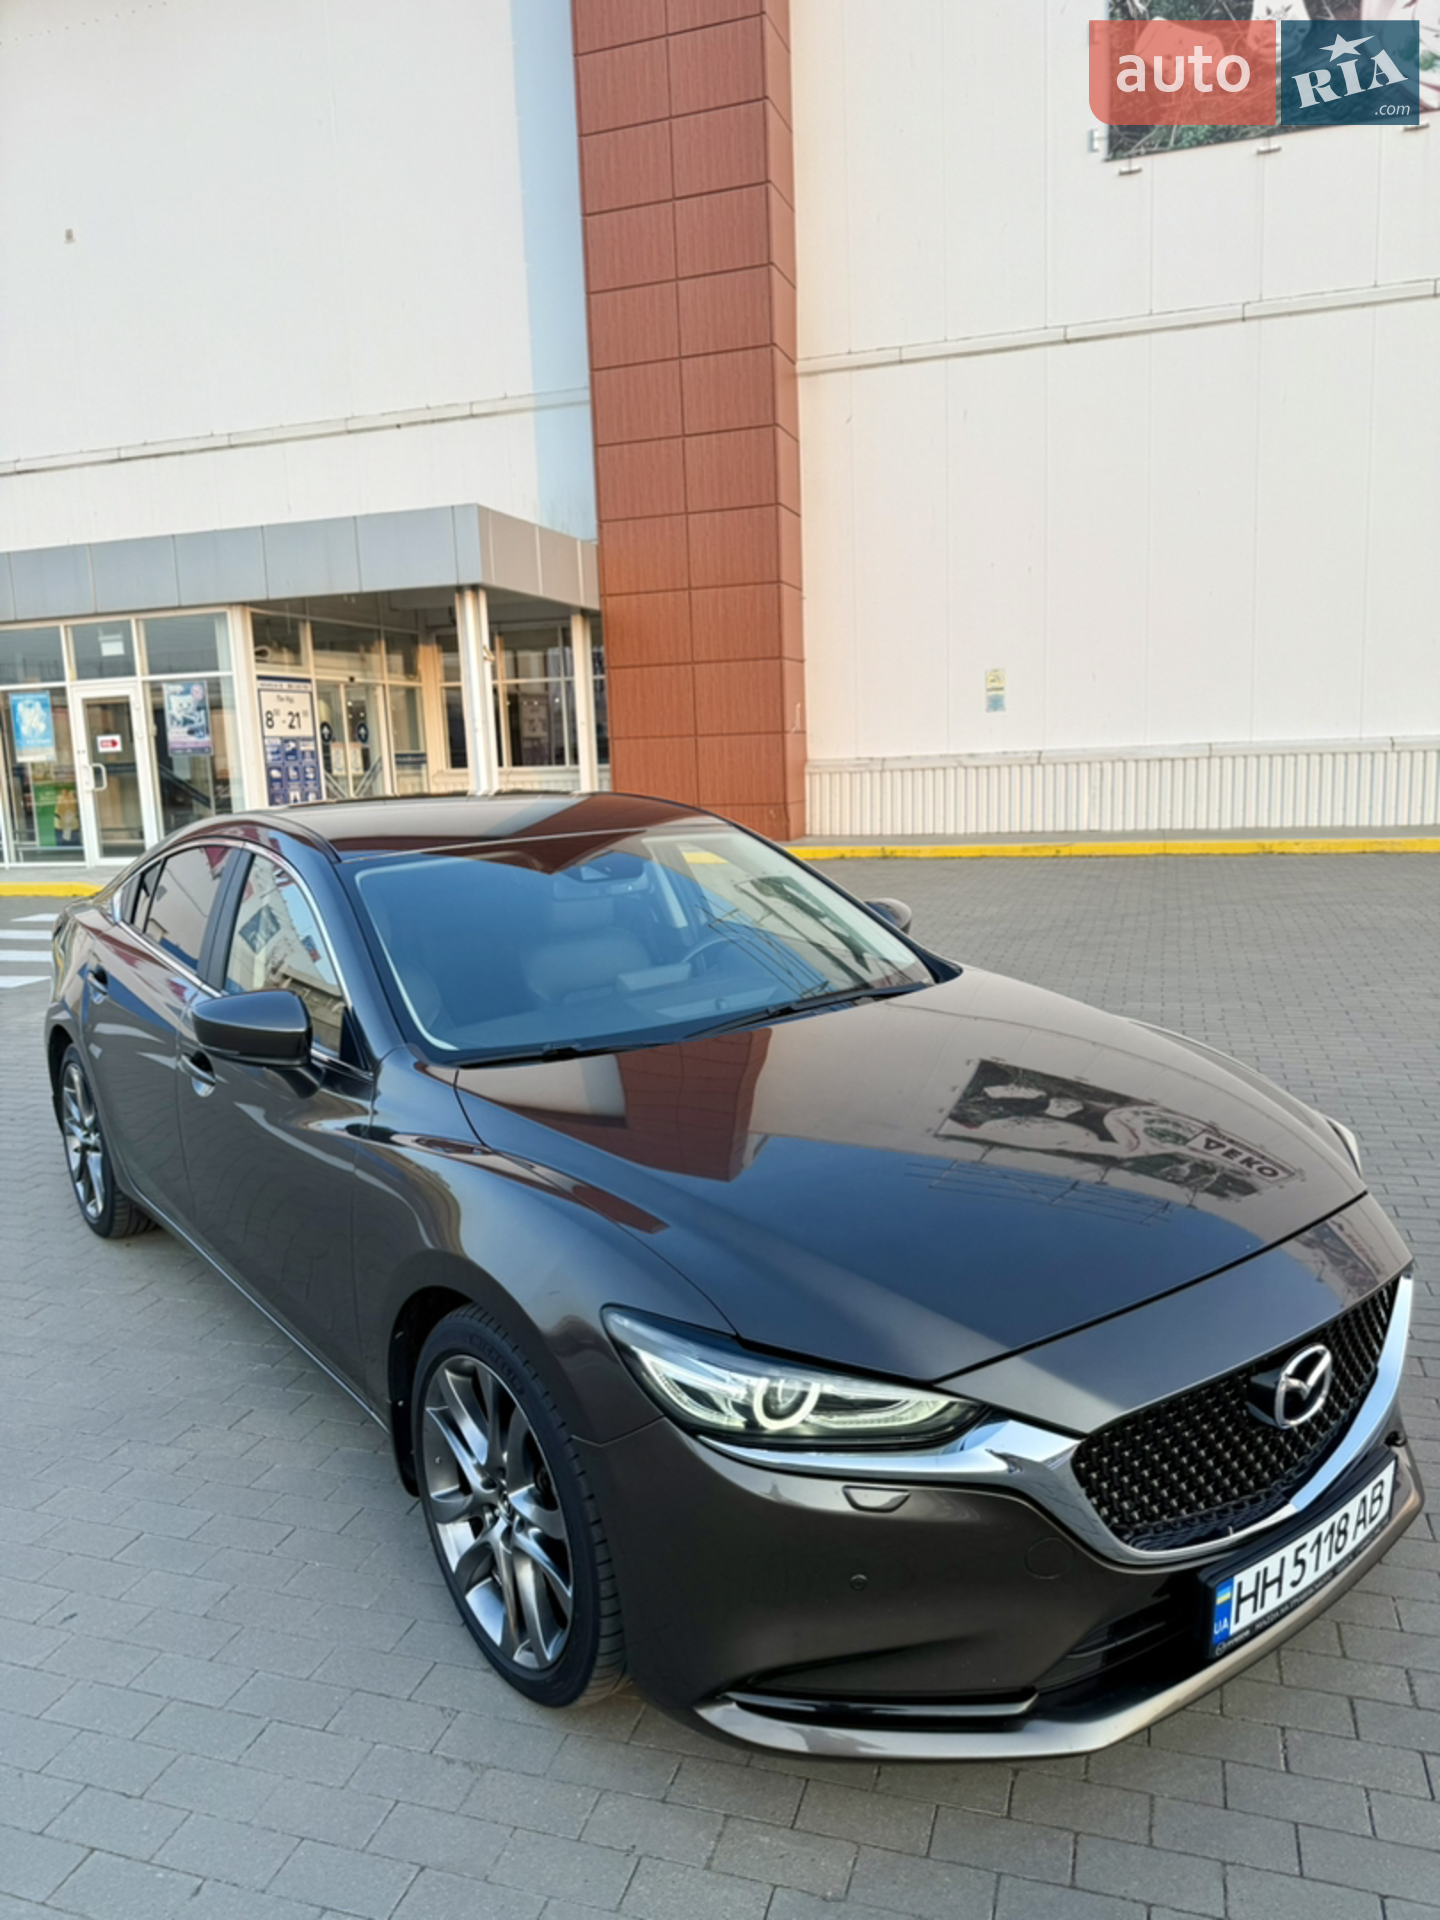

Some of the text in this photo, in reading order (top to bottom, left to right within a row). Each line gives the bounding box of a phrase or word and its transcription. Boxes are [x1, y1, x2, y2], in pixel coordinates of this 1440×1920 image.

[265, 710, 275, 729] 8
[1289, 1512, 1350, 1588] 5118
[1352, 1479, 1385, 1541] AB
[1213, 1616, 1230, 1636] UA
